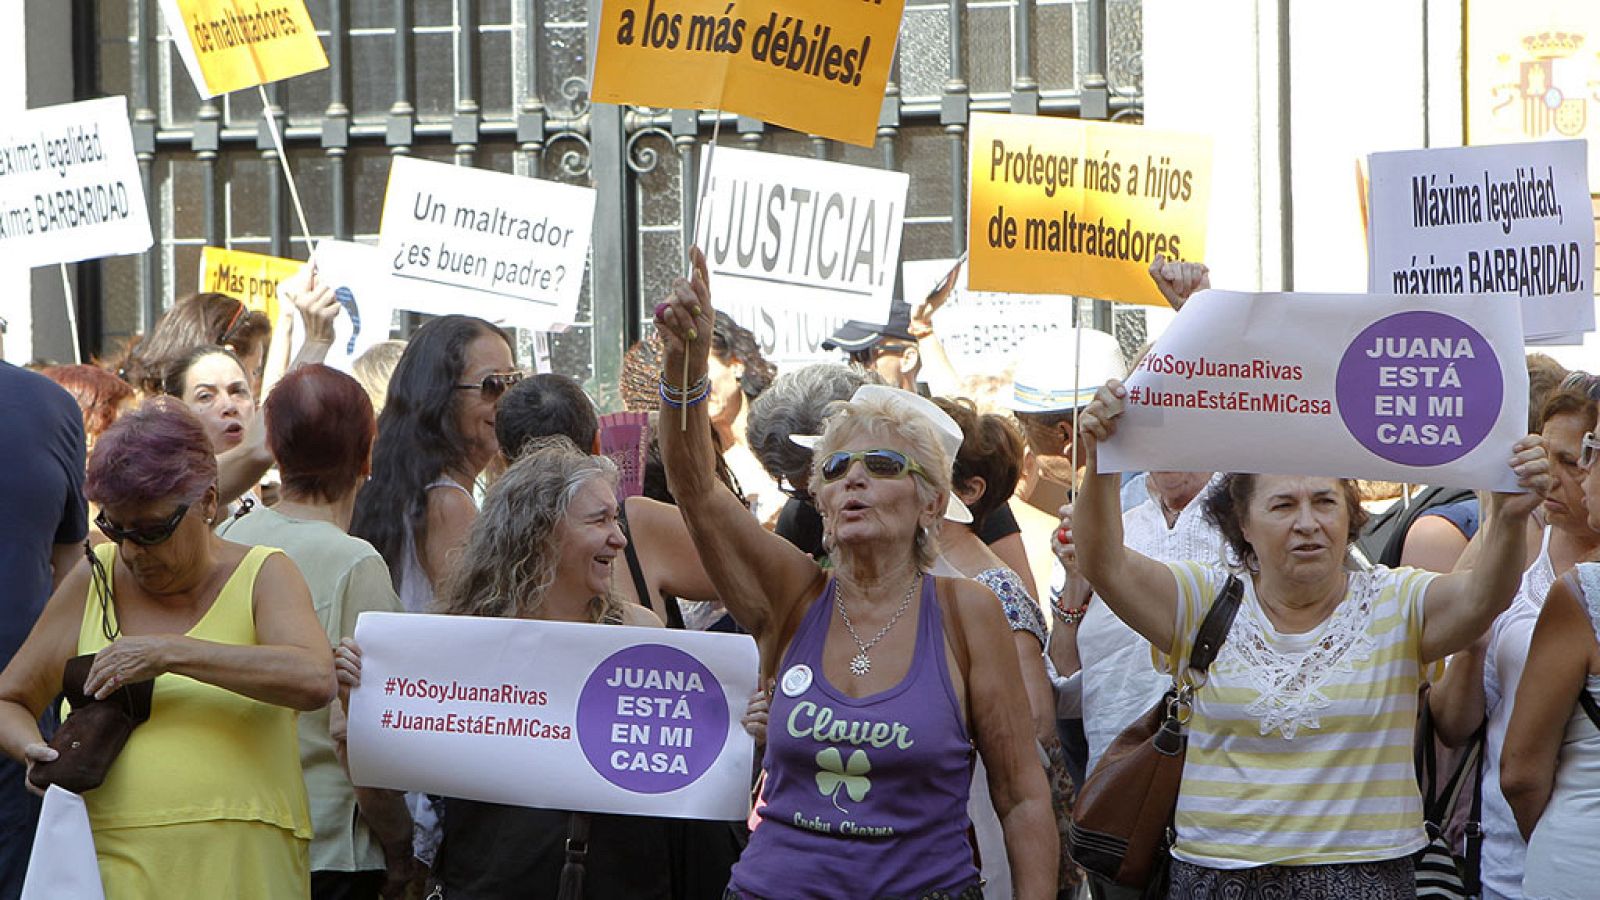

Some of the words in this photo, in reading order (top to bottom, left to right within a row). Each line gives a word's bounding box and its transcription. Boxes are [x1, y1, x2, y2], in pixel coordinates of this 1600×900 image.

[194, 13, 214, 53] de
[616, 8, 634, 46] a
[641, 0, 682, 50] los
[686, 3, 746, 54] más
[751, 12, 872, 87] débiles!
[990, 139, 1078, 198] Proteger
[1083, 150, 1121, 194] más
[1127, 161, 1138, 195] a
[1144, 155, 1193, 210] hijos
[1412, 174, 1482, 228] Máxima
[1484, 166, 1563, 235] legalidad,
[413, 192, 446, 224] Un
[454, 207, 574, 248] maltrador
[704, 176, 894, 287] ¡JUSTICIA!
[988, 205, 1018, 249] de
[1025, 210, 1186, 263] maltratadores.
[213, 264, 244, 293] ¡Más
[393, 243, 431, 270] ¿es
[437, 242, 487, 277] buen
[491, 259, 567, 292] padre?
[1393, 254, 1463, 294] máxima
[1468, 242, 1584, 297] BARBARIDAD.
[1366, 337, 1475, 359] JUANA
[1379, 362, 1461, 389] ESTÁ
[1129, 385, 1332, 415] #JuanaEstáEnMiCasa
[1374, 395, 1417, 417] EN
[1427, 396, 1463, 418] MI
[1376, 424, 1462, 446] CASA
[384, 677, 548, 706] #YoSoyJuanaRivas
[607, 667, 705, 693] JUANA
[616, 691, 692, 720] ESTÁ
[381, 710, 571, 740] #JuanaEstáEnMiCasa
[611, 724, 650, 745] EN
[659, 726, 693, 748] MI
[787, 701, 914, 750] Clover
[610, 752, 689, 775] CASA
